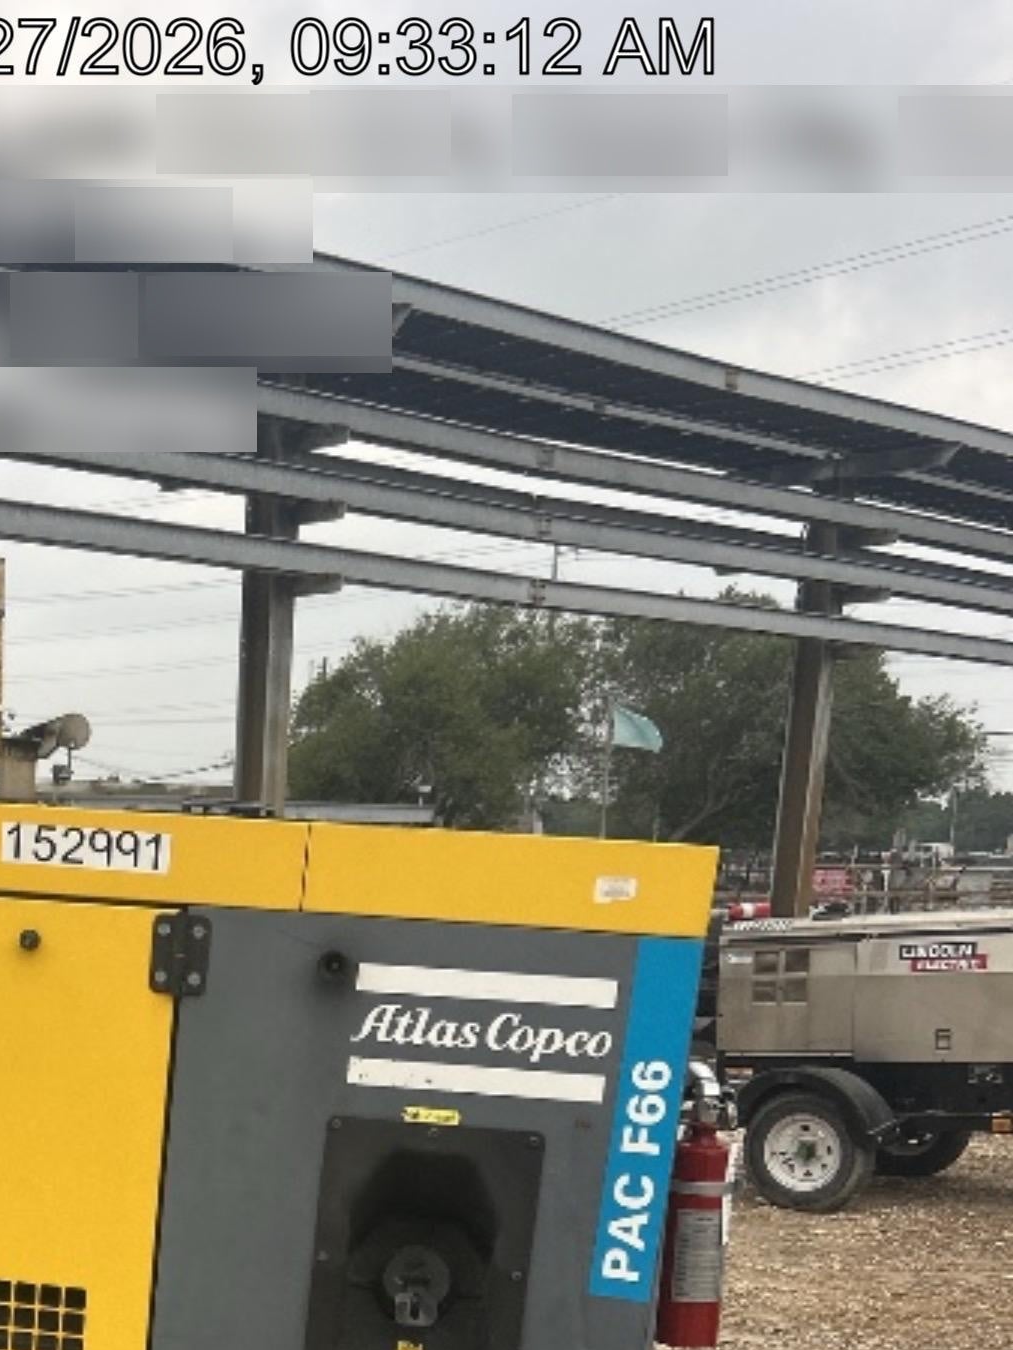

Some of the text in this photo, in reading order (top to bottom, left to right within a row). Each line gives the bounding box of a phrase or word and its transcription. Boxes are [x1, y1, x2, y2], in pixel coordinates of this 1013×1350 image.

[7, 822, 162, 871] 152991
[350, 1004, 612, 1062] Atlas Copco
[601, 1060, 673, 1282] PAC F66
